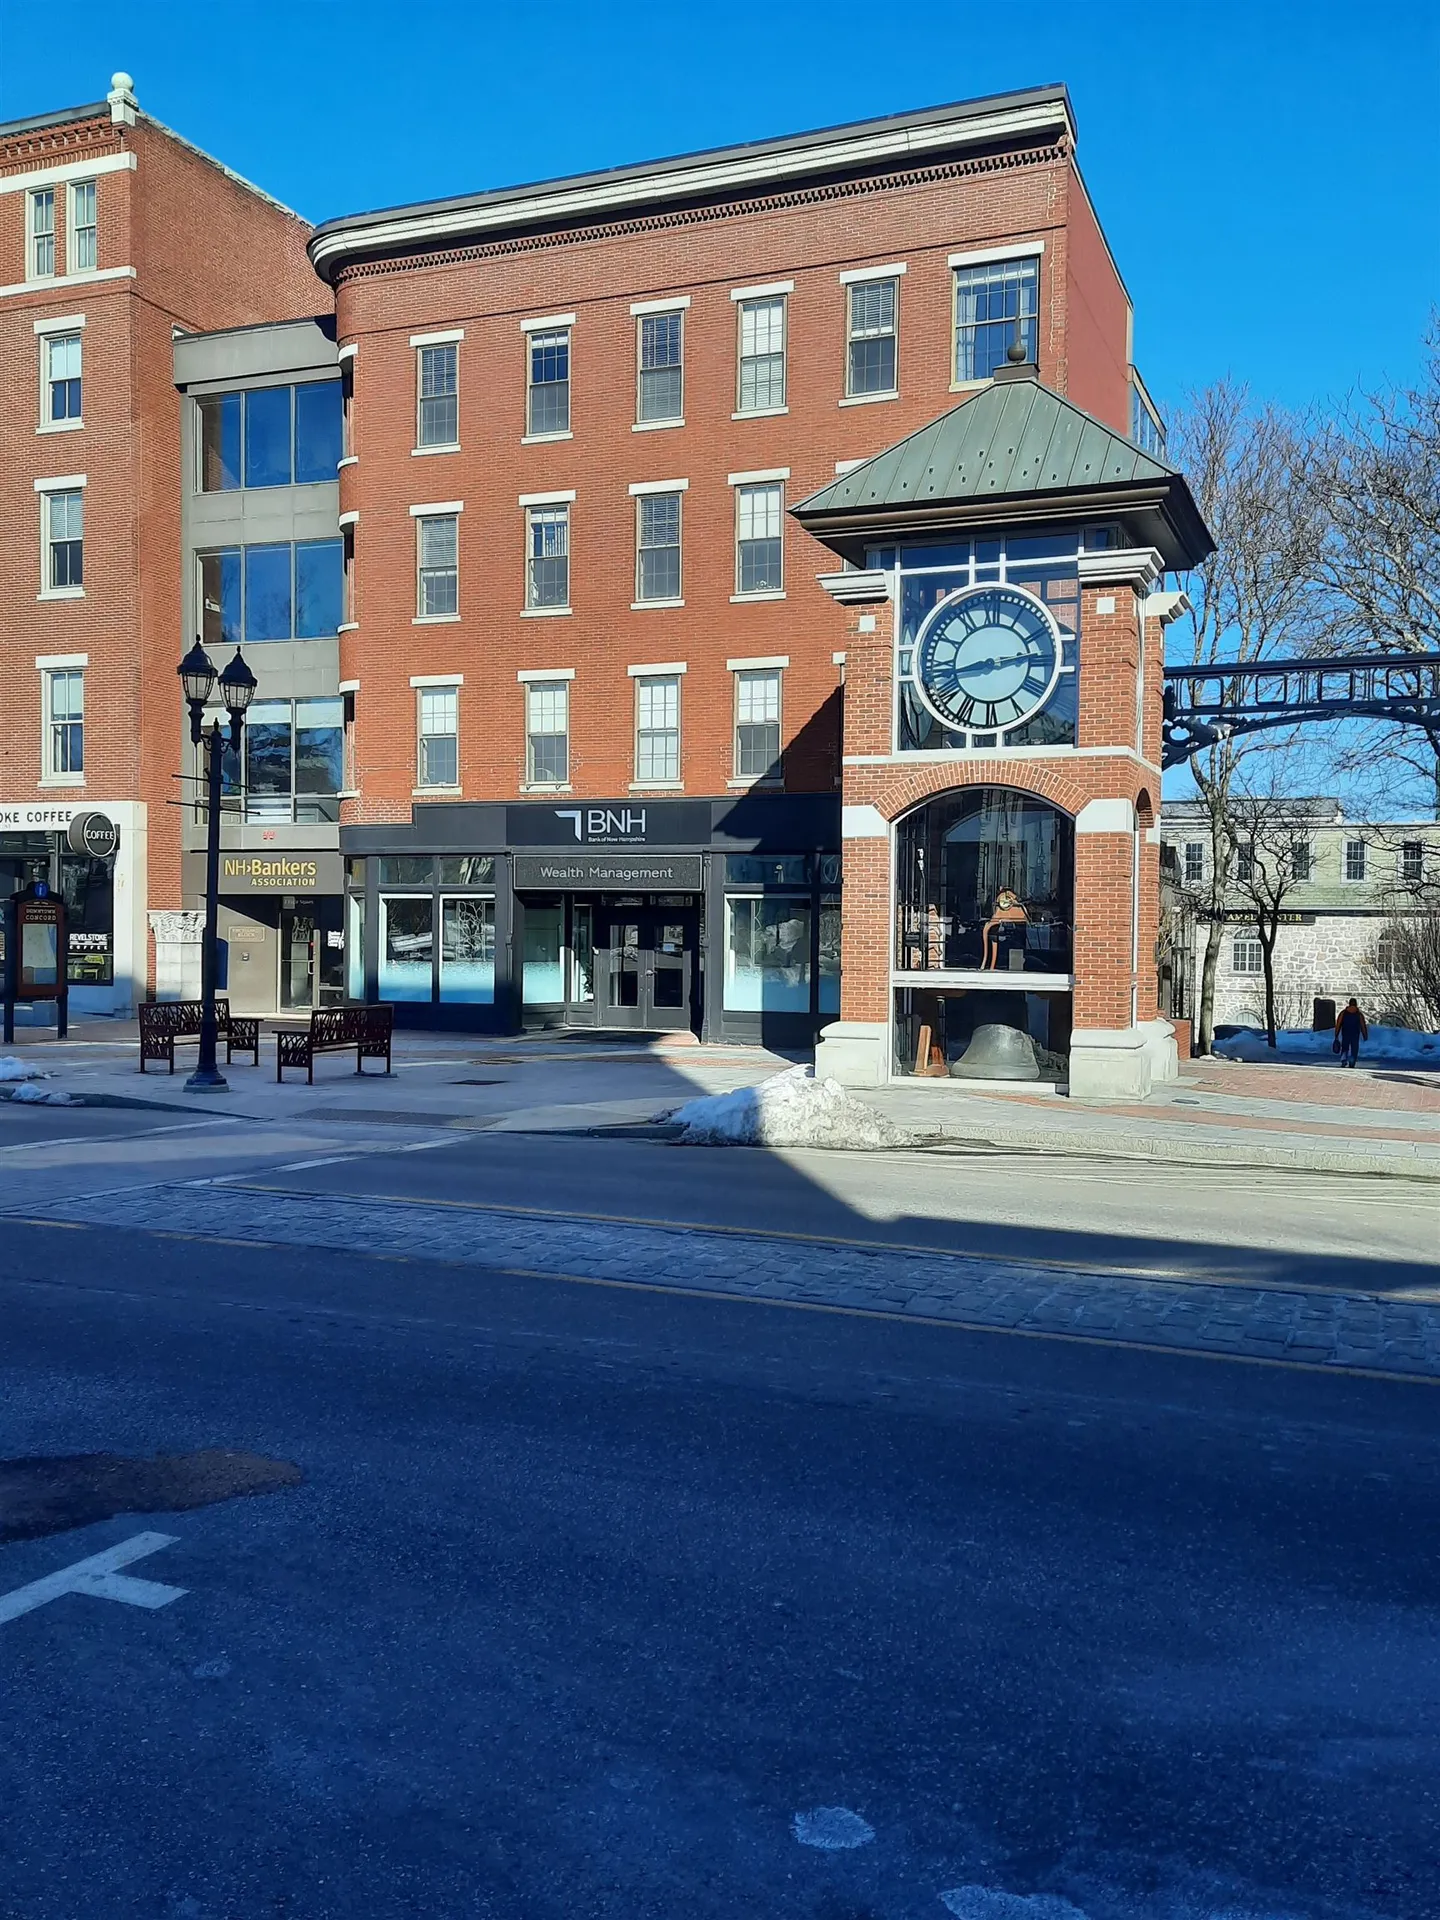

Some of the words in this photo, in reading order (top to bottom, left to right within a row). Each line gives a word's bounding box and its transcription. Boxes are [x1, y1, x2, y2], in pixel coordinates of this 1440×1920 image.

[27, 811, 72, 822] COFFEE
[588, 809, 646, 833] BNH
[86, 830, 114, 840] COFFEE
[540, 867, 584, 878] Wealth
[589, 867, 674, 880] Management
[251, 878, 316, 886] ASSOCIATION
[1222, 913, 1257, 921] AMEL
[69, 933, 107, 941] REVELSTOKE
